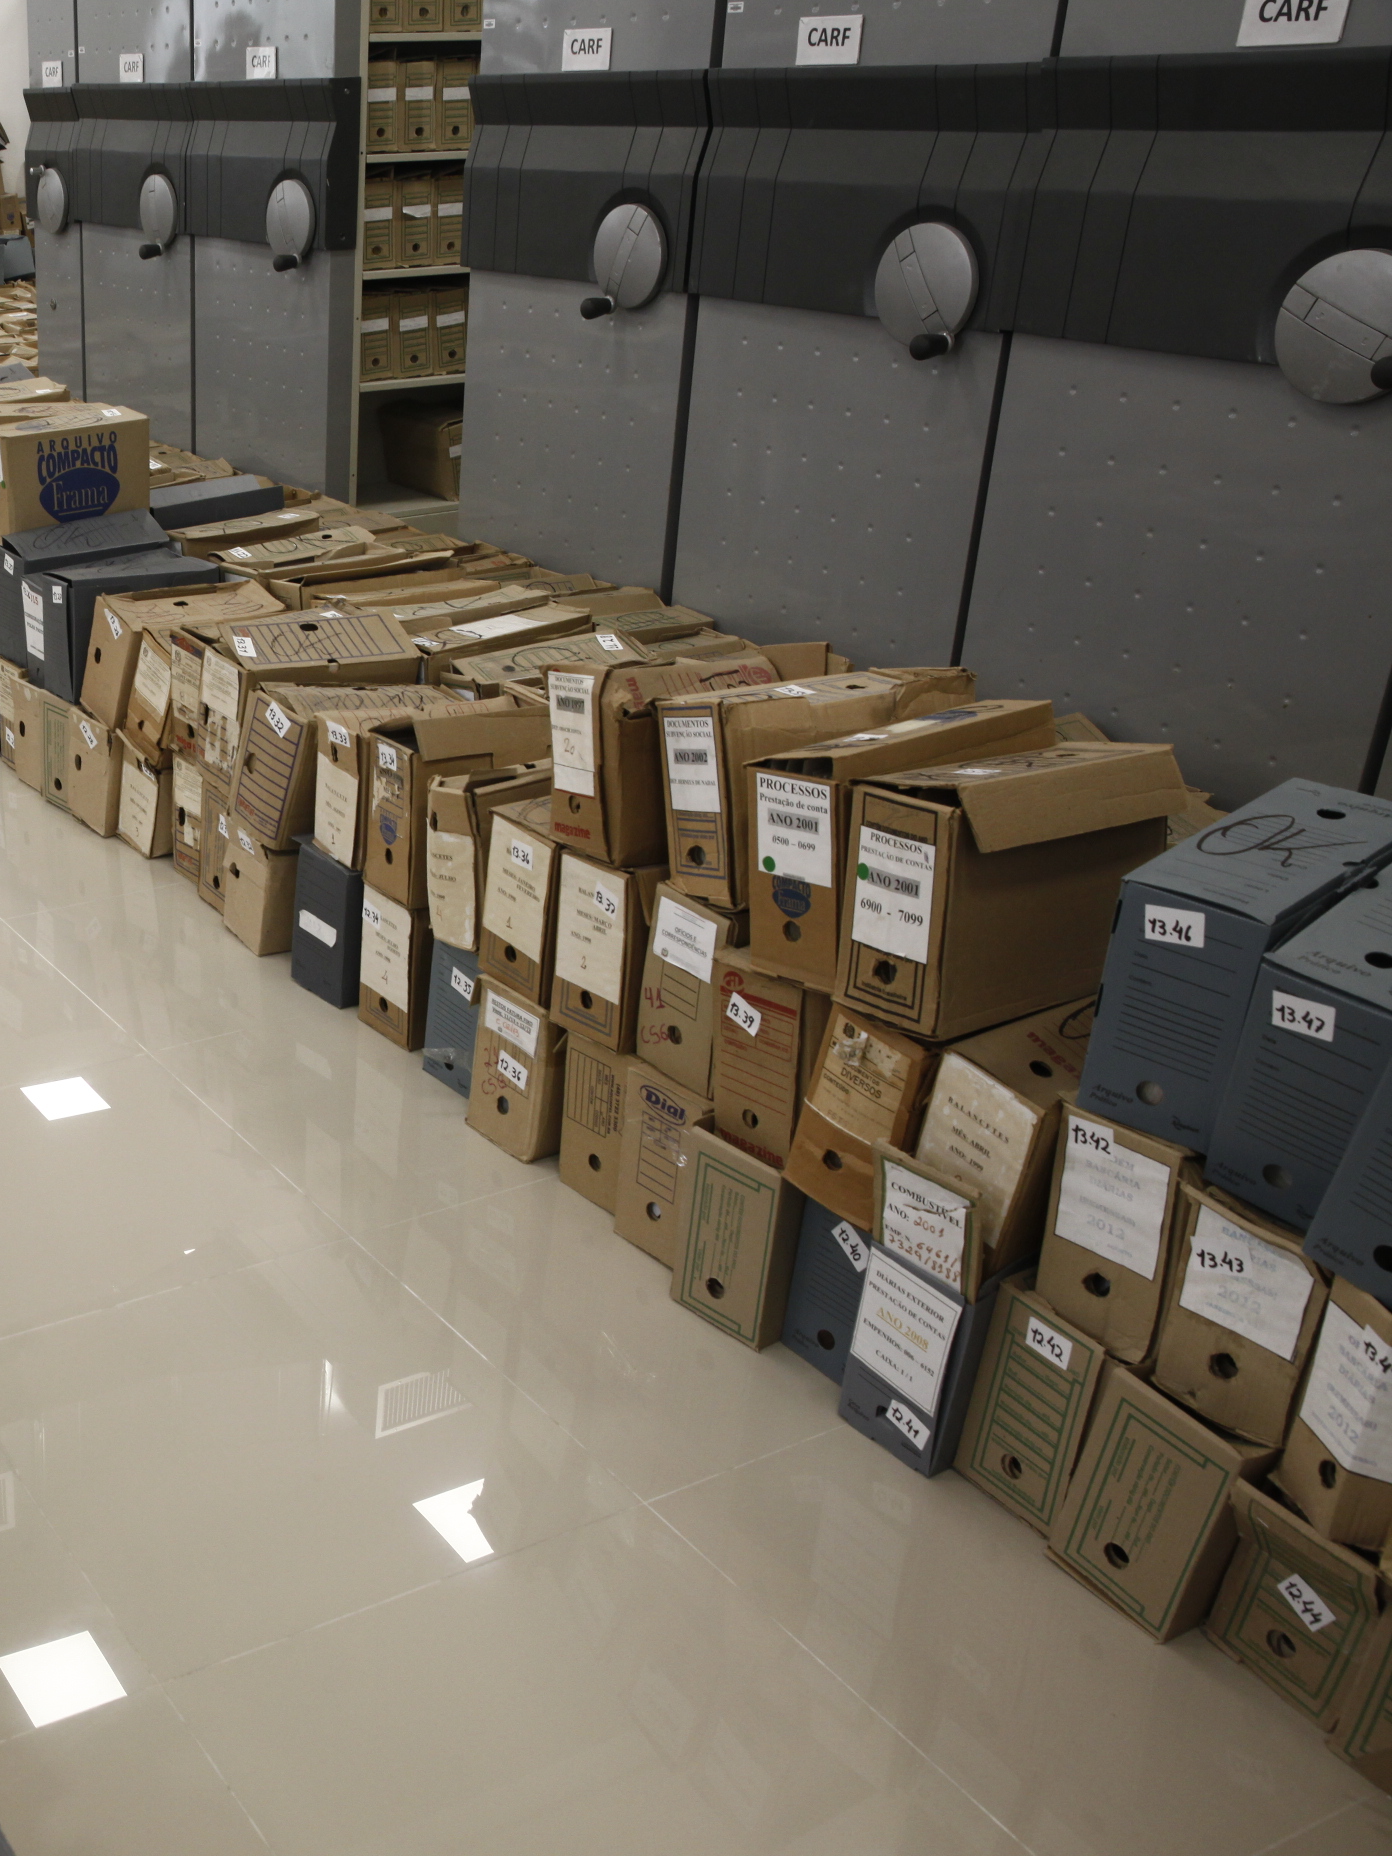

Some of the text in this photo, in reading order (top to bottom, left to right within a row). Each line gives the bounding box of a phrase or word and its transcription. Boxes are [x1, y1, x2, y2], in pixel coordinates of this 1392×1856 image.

[1259, 0, 1328, 22] CARF
[570, 38, 603, 56] CARF
[807, 27, 851, 48] CARF
[45, 66, 59, 78] CARF
[123, 61, 139, 73] CARF
[251, 54, 271, 68] CARF
[37, 431, 118, 455] ARQUIVO
[37, 444, 119, 486] COMPACTO
[51, 480, 111, 514] Frama
[555, 676, 584, 685] DOCUMENTOS
[573, 686, 590, 695] SOCIAL
[557, 697, 585, 710] ANO 1997
[269, 708, 284, 732] 13.32
[667, 720, 709, 729] DOCUMENTOS
[331, 730, 347, 745] 13.33
[674, 750, 708, 763] ANO 2002
[759, 776, 828, 800] PROCESSOS
[759, 792, 828, 815] Prestação de conta
[554, 822, 591, 839] magazine
[768, 812, 819, 833] ANO 2001
[512, 846, 530, 865] 13.36
[772, 835, 816, 851] 0500 0699
[870, 832, 922, 855] PROCESSOS
[860, 845, 933, 871] PRESTAÇÃO DE CONTAS
[869, 871, 920, 896] ANO 2001
[596, 890, 616, 915] 13.37
[777, 889, 806, 911] Frama
[860, 897, 924, 927] 6900 7099
[364, 907, 379, 925] 12.34
[593, 916, 612, 930] MARÇO
[1148, 918, 1192, 942] 13.46
[661, 929, 707, 958] CORRESPONDÊNCIAS
[453, 974, 472, 995] 12.35
[729, 1002, 755, 1028] 13.39
[1275, 1005, 1325, 1033] 13.47
[500, 1058, 522, 1082] 12.36
[840, 1067, 882, 1099] DIVERSOS
[644, 1087, 686, 1121] Dial
[947, 1095, 1010, 1144] BALANCETES
[719, 1128, 784, 1168] magazine
[951, 1125, 991, 1159] MÊS: ABRIL
[1072, 1124, 1112, 1155] 13.42
[949, 1144, 984, 1172] ANO: 1999
[890, 1181, 963, 1230] COMBUSTÍVEL
[886, 1202, 945, 1239] ANO: 2001
[1086, 1214, 1126, 1242] 2012
[837, 1226, 862, 1262] 12.40
[1196, 1249, 1245, 1274] 13.43
[876, 1270, 945, 1323] DIÁRIAS EXTERIOR
[1216, 1284, 1262, 1316] 2012
[868, 1280, 946, 1341] PRESTAÇÃO DE CONTAS
[863, 1317, 903, 1353] EMPENHOS:
[876, 1307, 930, 1350] ANO 2008
[1030, 1326, 1064, 1363] 12.42
[1363, 1340, 1392, 1374] 13.4
[875, 1349, 900, 1372] CAIXA:
[891, 1406, 920, 1440] 12.41
[1327, 1405, 1360, 1443] 2012
[1284, 1580, 1324, 1626] 12.44
